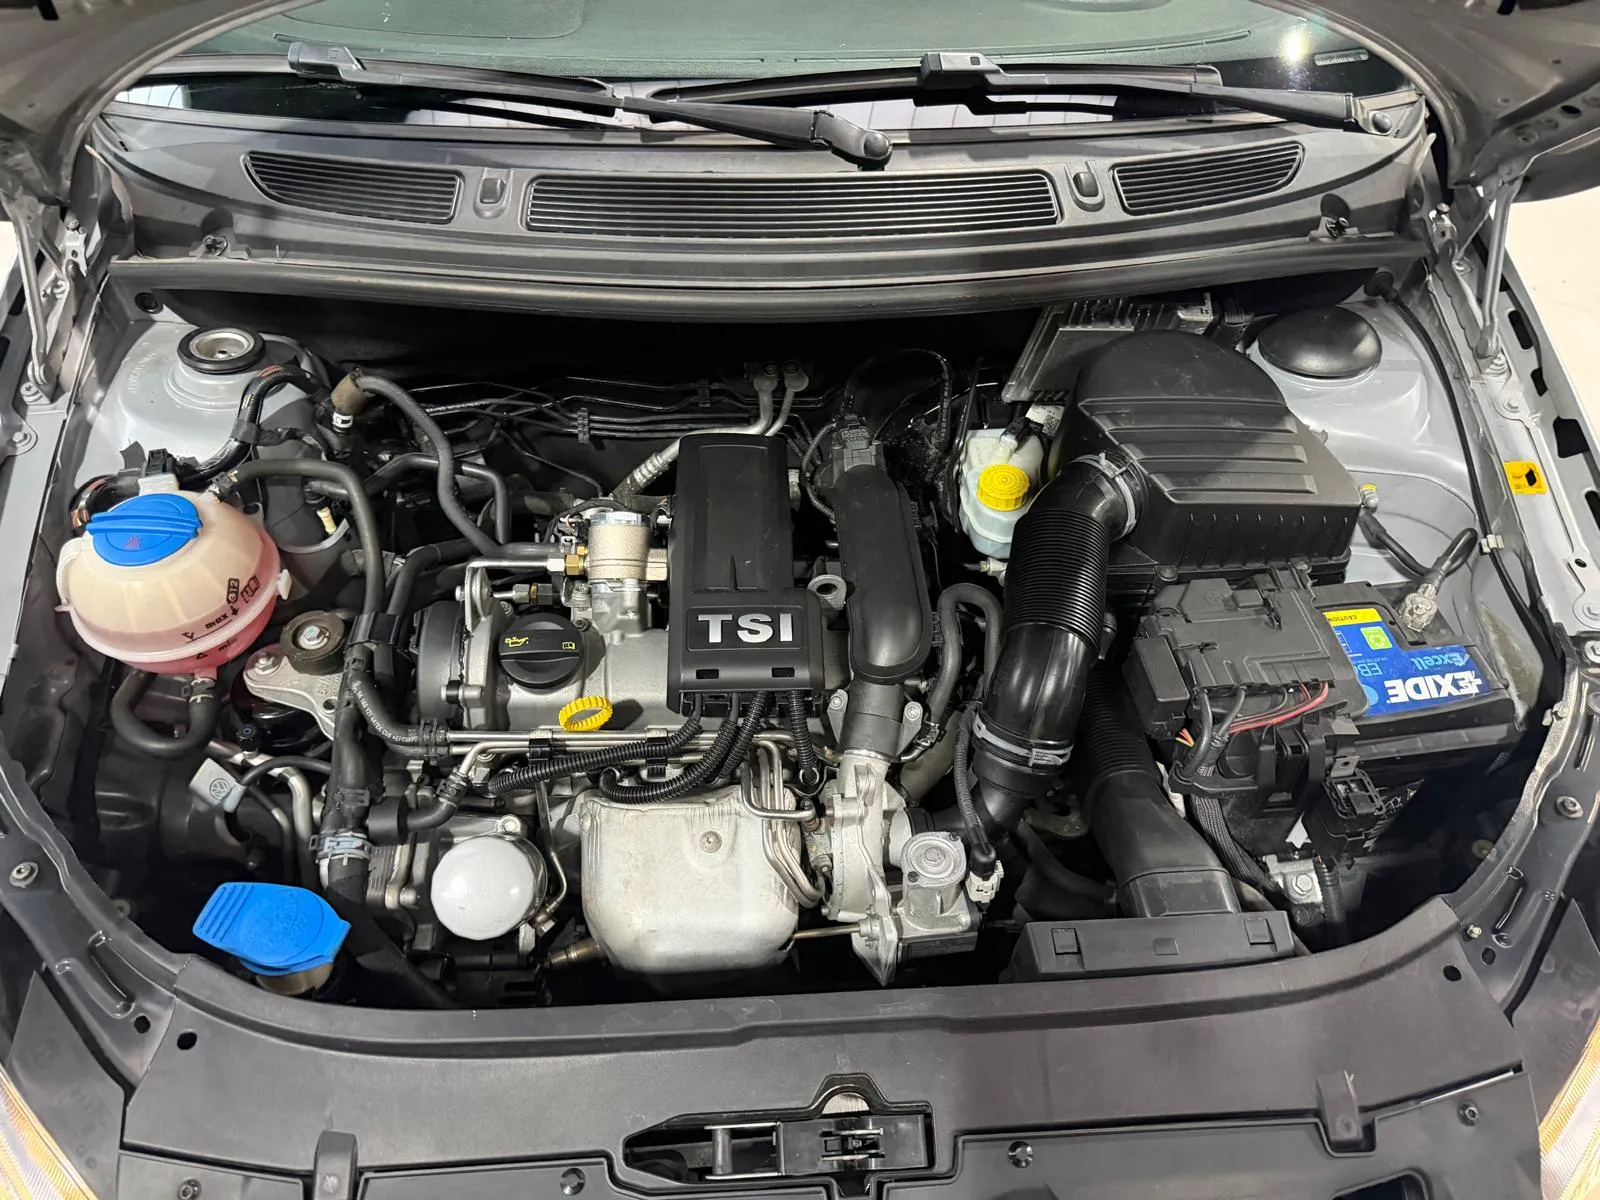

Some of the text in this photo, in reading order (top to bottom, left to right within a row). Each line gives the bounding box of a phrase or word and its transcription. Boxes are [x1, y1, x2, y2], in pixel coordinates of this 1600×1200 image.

[205, 613, 228, 629] max
[697, 613, 794, 644] TSI
[1384, 670, 1482, 704] EXIDE
